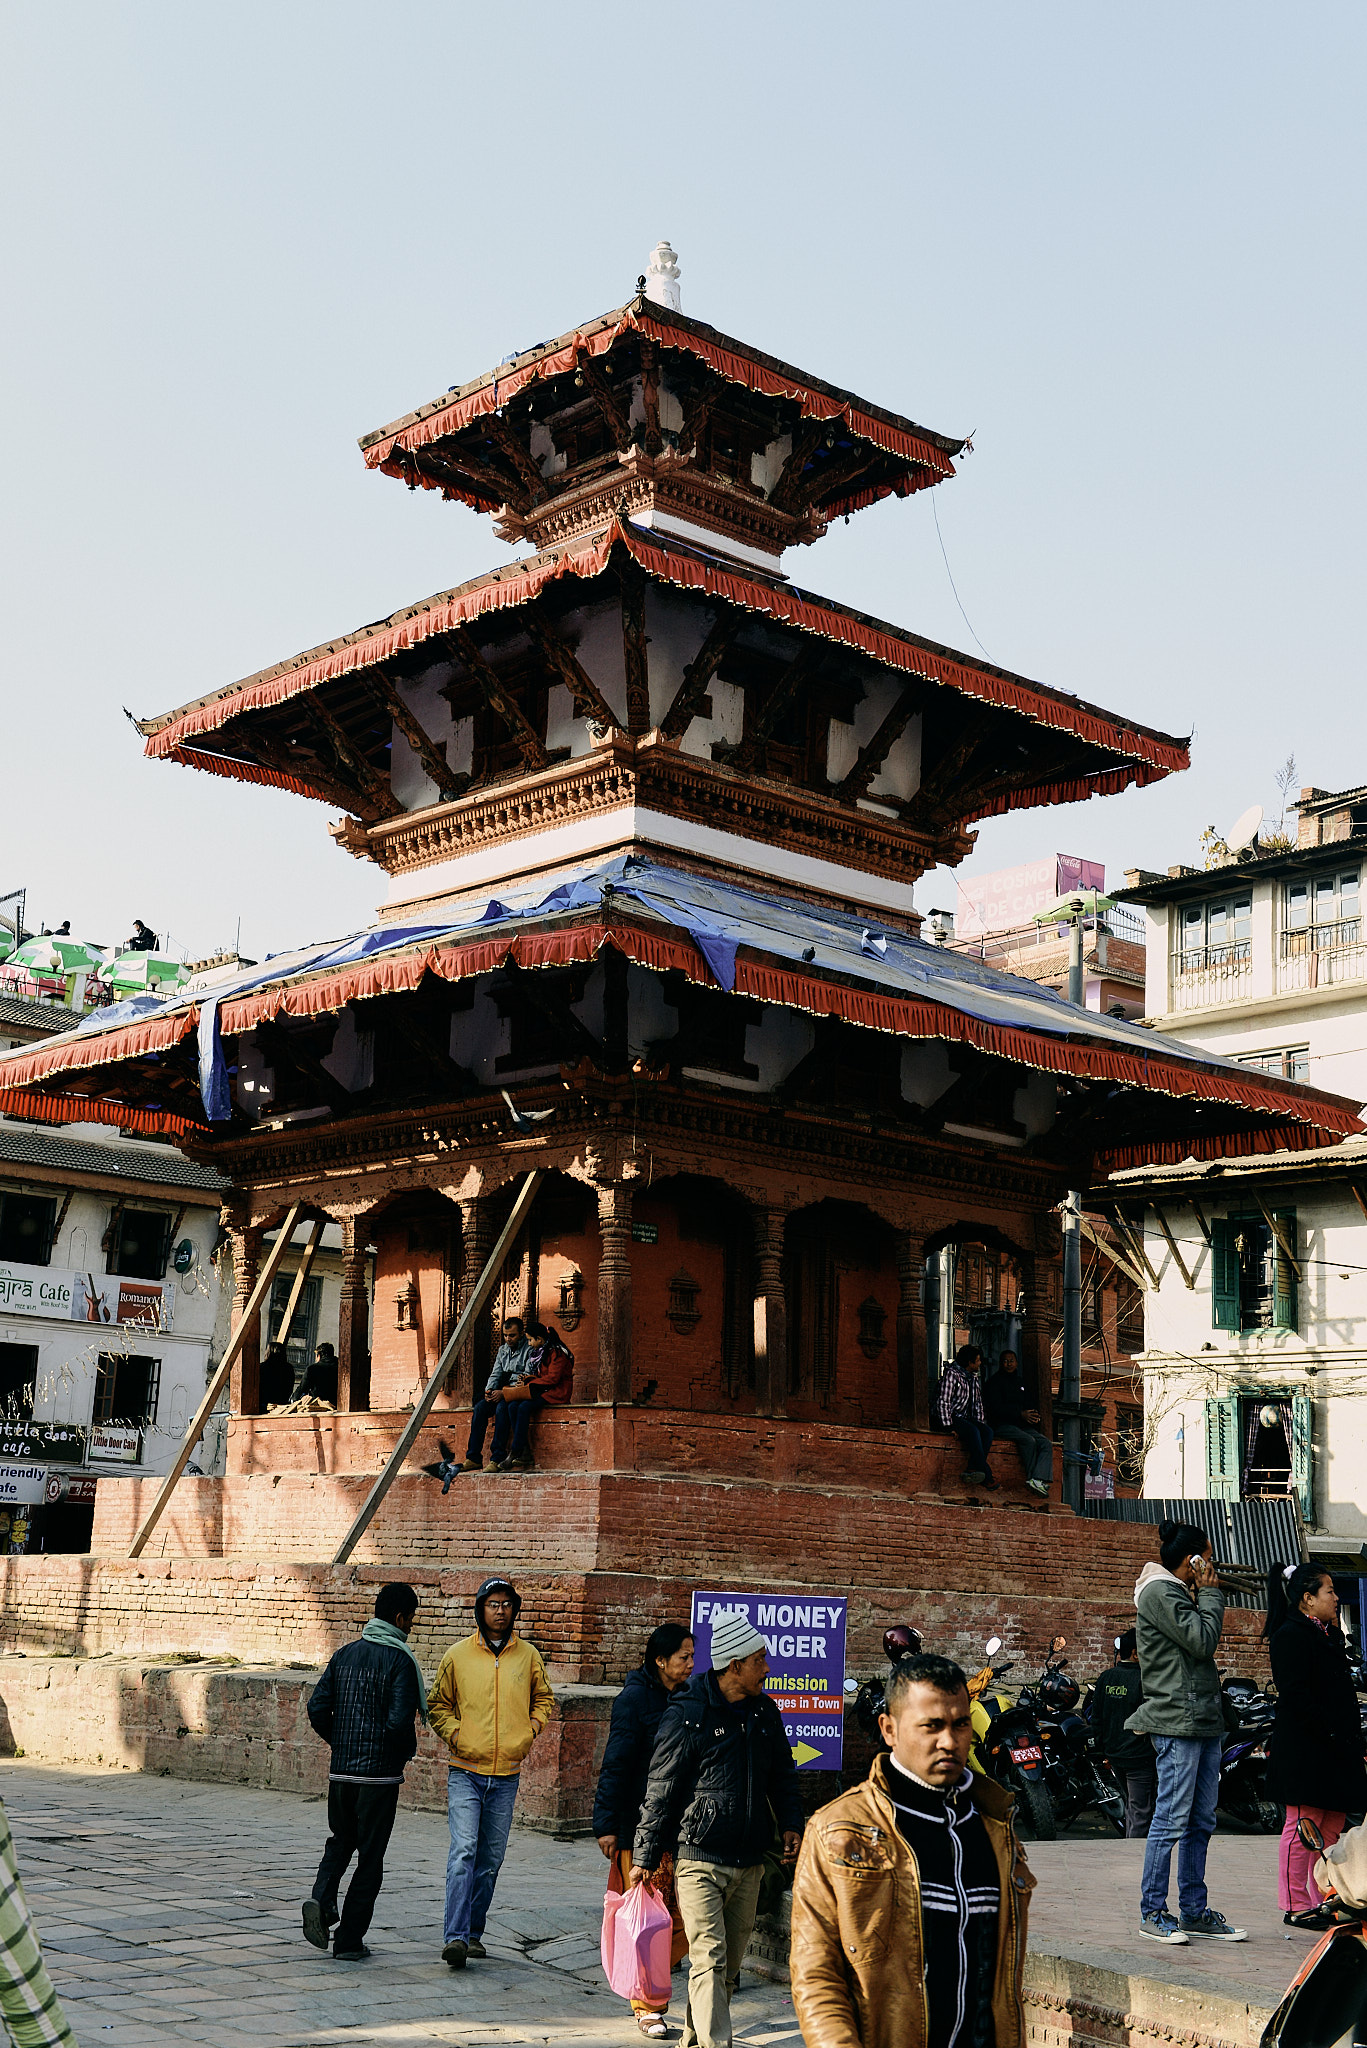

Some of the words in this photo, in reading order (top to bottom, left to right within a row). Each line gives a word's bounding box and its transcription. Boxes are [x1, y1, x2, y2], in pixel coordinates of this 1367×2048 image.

[993, 866, 1050, 893] COSMO
[987, 901, 1008, 919] DE
[40, 1283, 70, 1301] Cafe
[3, 1442, 31, 1456] cafe
[93, 1435, 108, 1447] Little
[109, 1436, 122, 1449] Door
[123, 1438, 136, 1450] Cafe
[0, 1466, 45, 1481] riendly
[757, 1604, 843, 1628] MONEY
[764, 1673, 828, 1691] mission
[799, 1696, 809, 1709] in
[812, 1696, 840, 1709] Town
[795, 1725, 841, 1738] SCHOOL
